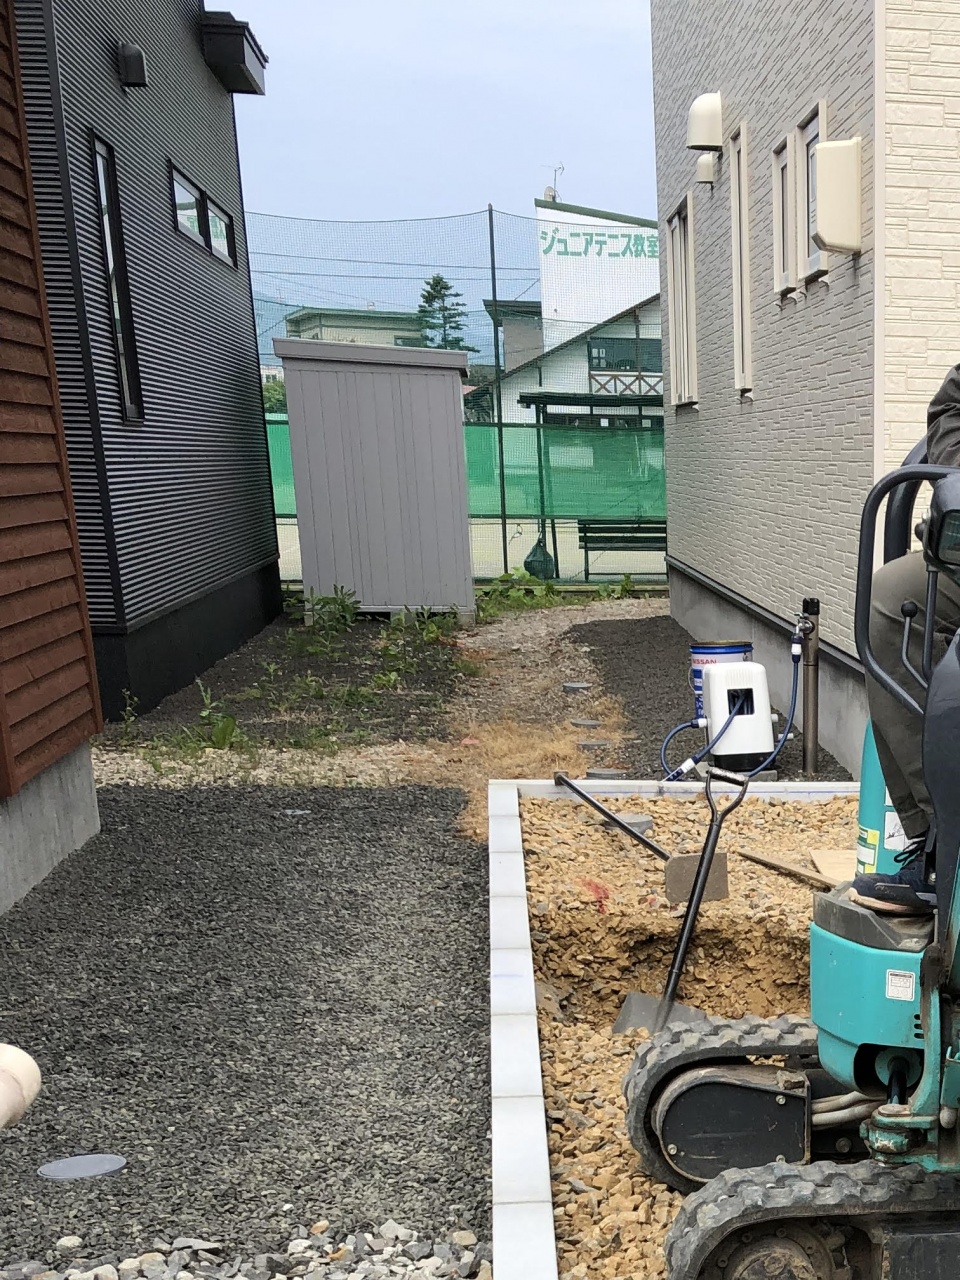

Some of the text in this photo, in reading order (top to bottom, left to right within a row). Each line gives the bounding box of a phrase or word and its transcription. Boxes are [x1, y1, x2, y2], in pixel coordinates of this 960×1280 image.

[540, 227, 659, 258] ジュニアテニス教室
